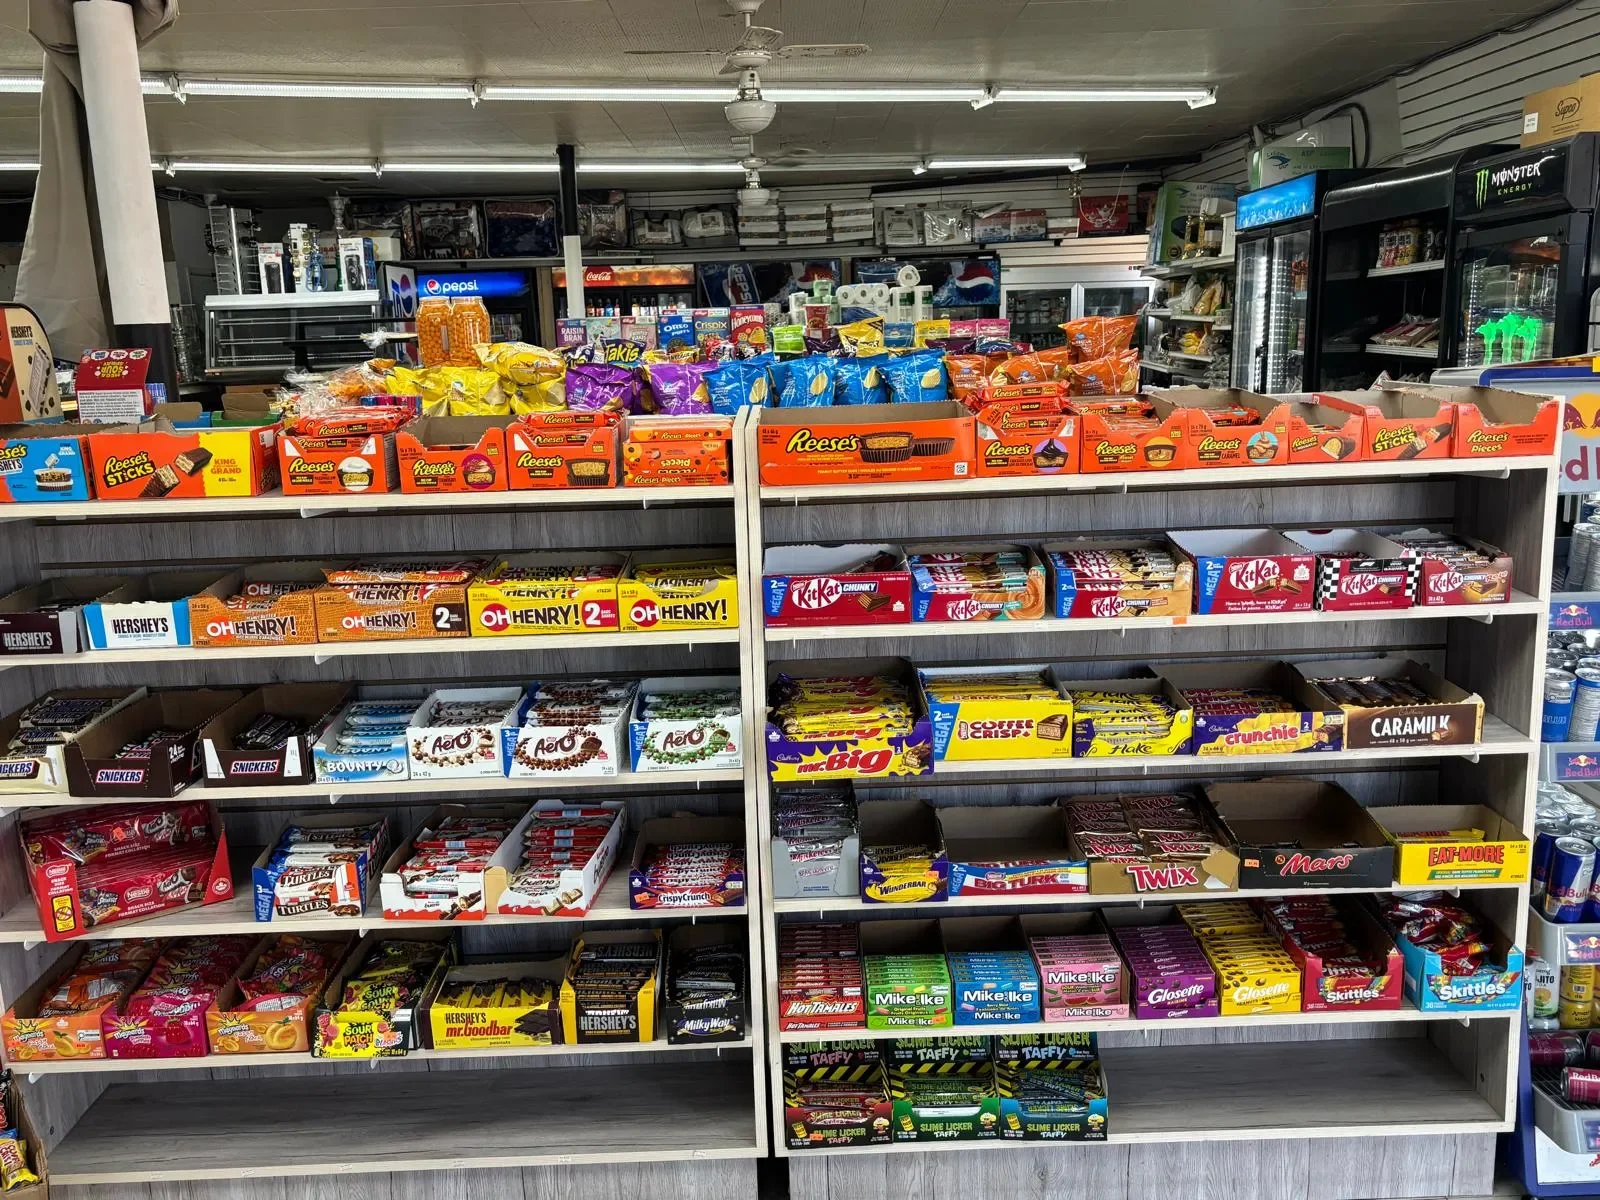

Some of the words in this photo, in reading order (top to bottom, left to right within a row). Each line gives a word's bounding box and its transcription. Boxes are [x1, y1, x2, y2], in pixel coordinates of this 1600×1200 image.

[1497, 182, 1533, 195] ENERGY
[442, 279, 479, 296] pepsi
[695, 320, 727, 331] Crispix
[731, 314, 764, 331] Honeycomb
[561, 327, 585, 335] RAISIN
[564, 333, 582, 341] BRAN
[606, 342, 640, 363] Takis
[992, 388, 1021, 398] Reese's
[544, 414, 573, 424] Reese's
[319, 425, 346, 436] Reese's
[1375, 424, 1414, 443] Reese's
[1467, 429, 1510, 444] Reese's
[786, 428, 860, 458] Reese's
[985, 439, 1032, 456] Reese's
[1096, 441, 1137, 455] Reese's
[1198, 435, 1241, 452] Reese's
[1471, 444, 1503, 453] Pieces
[104, 452, 149, 475] Reese's
[289, 457, 335, 474] Reese's
[517, 453, 563, 468] Reese's
[211, 466, 242, 475] GRAND
[843, 583, 876, 593] CHUNKY
[480, 608, 512, 627] OH
[512, 603, 581, 627] HENRY!
[585, 602, 601, 625] 2
[630, 606, 660, 623] OH
[661, 598, 728, 621] HENRY!
[342, 613, 366, 629] OH
[365, 610, 417, 630] HENRY!
[435, 607, 451, 630] 2
[112, 617, 169, 634] HERSHEY'S
[207, 622, 235, 638] OH
[234, 615, 297, 637] HENRY!
[4, 632, 53, 647] HERSHEY'S
[969, 719, 1034, 730] COFFEE
[1370, 714, 1451, 738] CARAMILK
[969, 729, 1022, 740] CRISP
[1224, 724, 1299, 746] crunchie
[776, 754, 801, 762] Cadbury
[232, 760, 279, 773] SNICKERS
[326, 760, 383, 773] BOUNTY
[97, 771, 143, 783] SNICKERS
[1428, 844, 1505, 867] EAT-MORE
[1280, 853, 1354, 877] Mars
[282, 870, 329, 887] TURTLES
[520, 879, 554, 887] bueno
[974, 877, 1007, 891] BIG
[1007, 873, 1060, 890] TURK
[879, 881, 927, 897] WUNDERBAR
[658, 892, 711, 905] CrispyCrunch
[118, 910, 139, 919] FORMAT
[139, 904, 165, 915] COLLATION
[127, 904, 143, 912] SNACK
[277, 899, 329, 916] TURTLES
[1048, 972, 1089, 985] Mike
[1091, 972, 1115, 984] Ike
[365, 988, 393, 998] SOUR
[963, 990, 1004, 1003] Mike
[1008, 990, 1033, 1003] Ike
[1147, 983, 1205, 1005] Glosette
[1233, 981, 1290, 1003] Glosette
[1326, 988, 1381, 1004] Skittles
[1440, 982, 1506, 1001] Skittles
[875, 993, 915, 1006] Mike
[921, 993, 945, 1006] Ike
[1167, 998, 1188, 1006] RAISINS
[785, 1002, 809, 1017] HOT
[808, 1001, 858, 1014] TAMALES
[1065, 1008, 1093, 1017] Mike
[1095, 1008, 1113, 1017] Ike
[1167, 1009, 1189, 1018] Glosette
[445, 1012, 487, 1025] HERSHEY'S
[888, 1017, 915, 1025] Mike
[974, 1012, 1002, 1020] Mike
[1004, 1012, 1021, 1020] Ike
[580, 1015, 637, 1031] HERSHEY'S
[345, 1024, 372, 1036] SOUR
[343, 1034, 373, 1047] PATCH
[810, 1051, 853, 1066] TAFFY
[917, 1048, 959, 1062] TAFFY
[1022, 1046, 1067, 1060] TAFFY
[839, 1127, 866, 1137] LICKER
[920, 1123, 944, 1132] SLIME
[946, 1122, 973, 1131] LICKER
[1027, 1123, 1051, 1132] SLIME
[1053, 1122, 1080, 1131] LICKER
[827, 1137, 853, 1145] TAFFY
[934, 1131, 960, 1139] TAFFY
[1041, 1131, 1067, 1139] TAFFY
